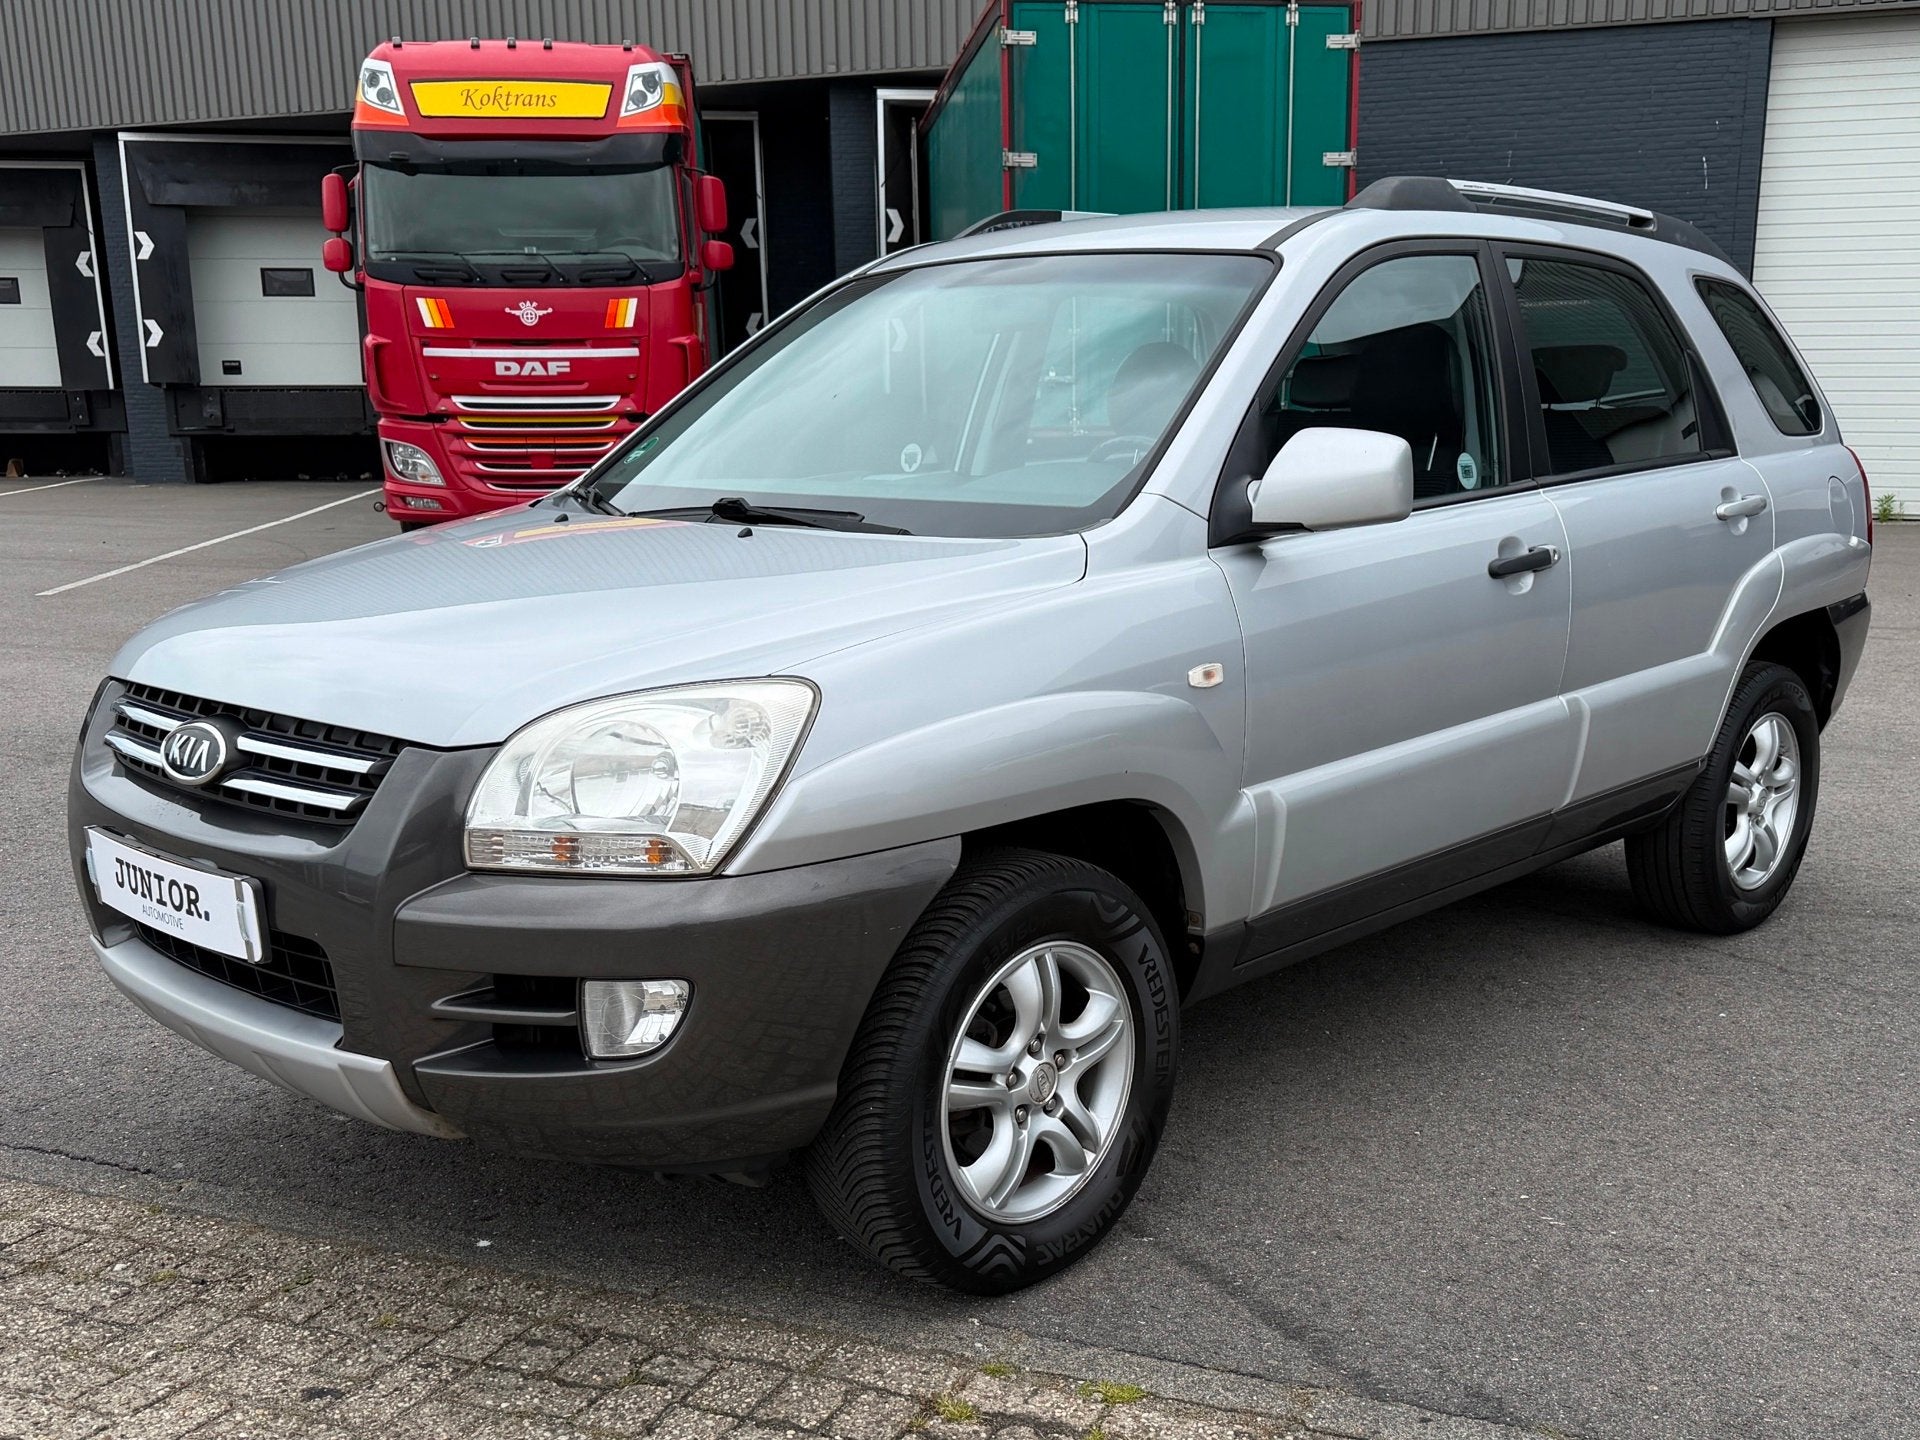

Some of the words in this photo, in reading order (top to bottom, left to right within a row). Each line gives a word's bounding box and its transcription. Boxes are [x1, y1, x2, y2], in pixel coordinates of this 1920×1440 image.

[460, 85, 558, 112] Koktrans
[518, 300, 538, 309] DAF
[495, 361, 570, 376] DAF
[168, 733, 210, 772] KIA
[115, 857, 210, 922] JUNIOR.
[142, 903, 184, 930] AUTOMOTIVE
[1138, 943, 1170, 1090] VREDESTEIN
